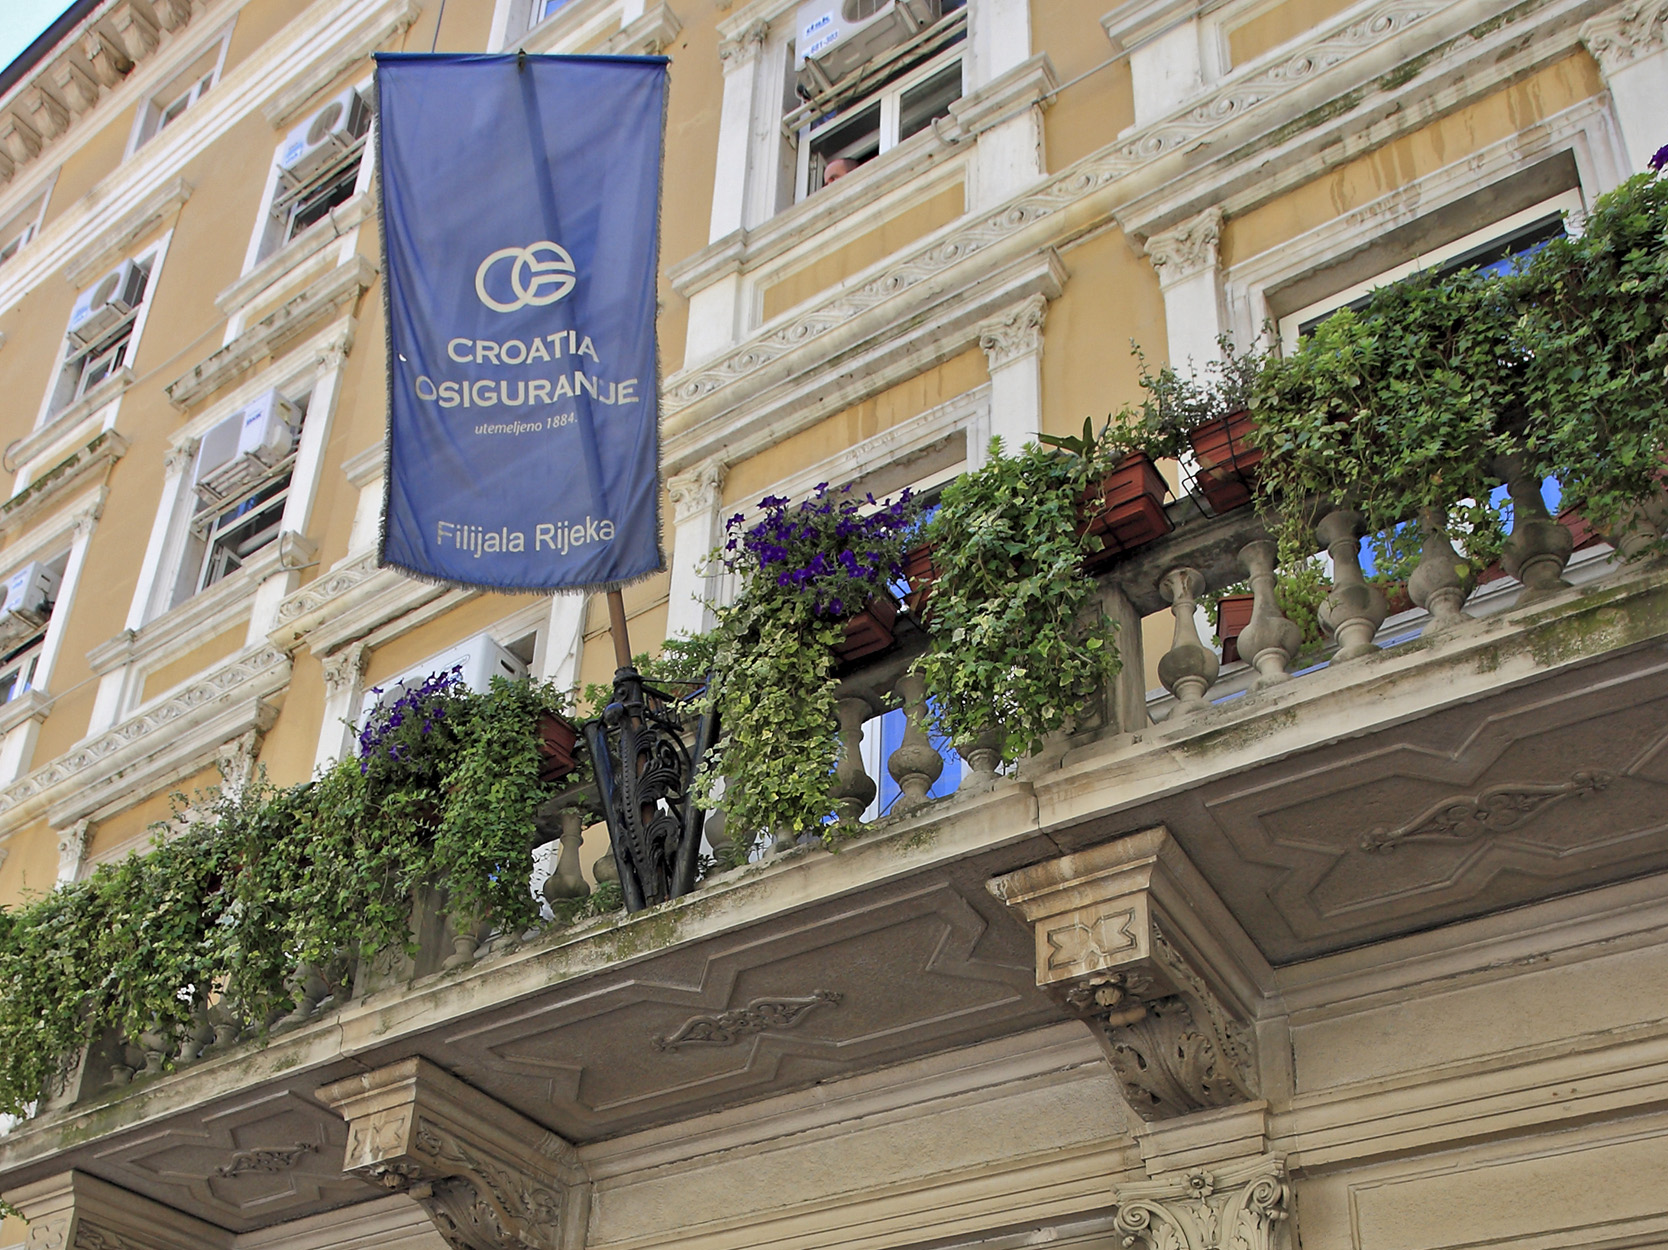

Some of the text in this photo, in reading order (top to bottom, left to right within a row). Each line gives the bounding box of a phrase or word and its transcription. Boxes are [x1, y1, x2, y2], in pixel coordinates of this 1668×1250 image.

[447, 329, 600, 365] CROATIA
[415, 371, 640, 408] OSIGURANJE
[474, 412, 578, 436] utemeljeno 1884.
[437, 515, 616, 559] Filijala Rijeka
